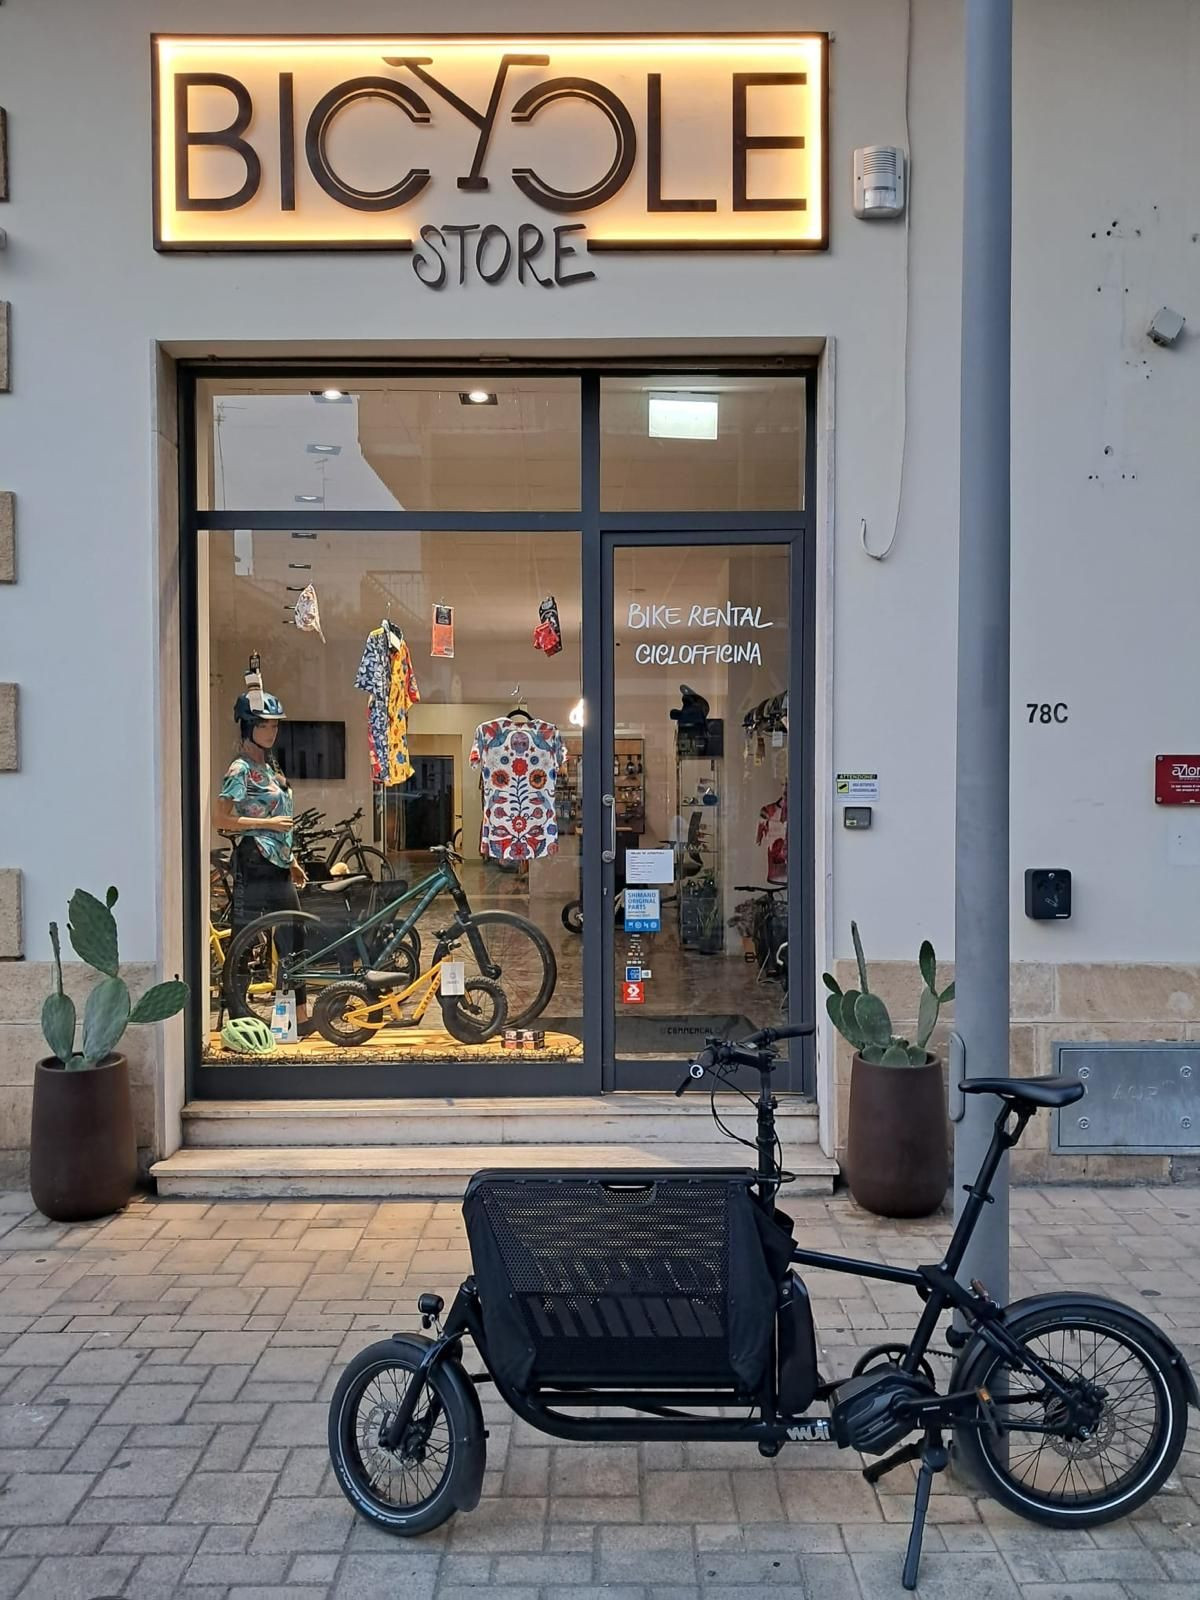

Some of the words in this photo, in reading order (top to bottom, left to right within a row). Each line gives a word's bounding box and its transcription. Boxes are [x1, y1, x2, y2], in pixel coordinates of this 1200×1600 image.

[174, 54, 807, 212] BICYCLE
[412, 222, 596, 291] STORE
[627, 603, 681, 629] BIKE
[687, 600, 774, 628] RENTAL
[635, 641, 762, 666] CICLOFFICINA
[1026, 702, 1068, 724] 78C
